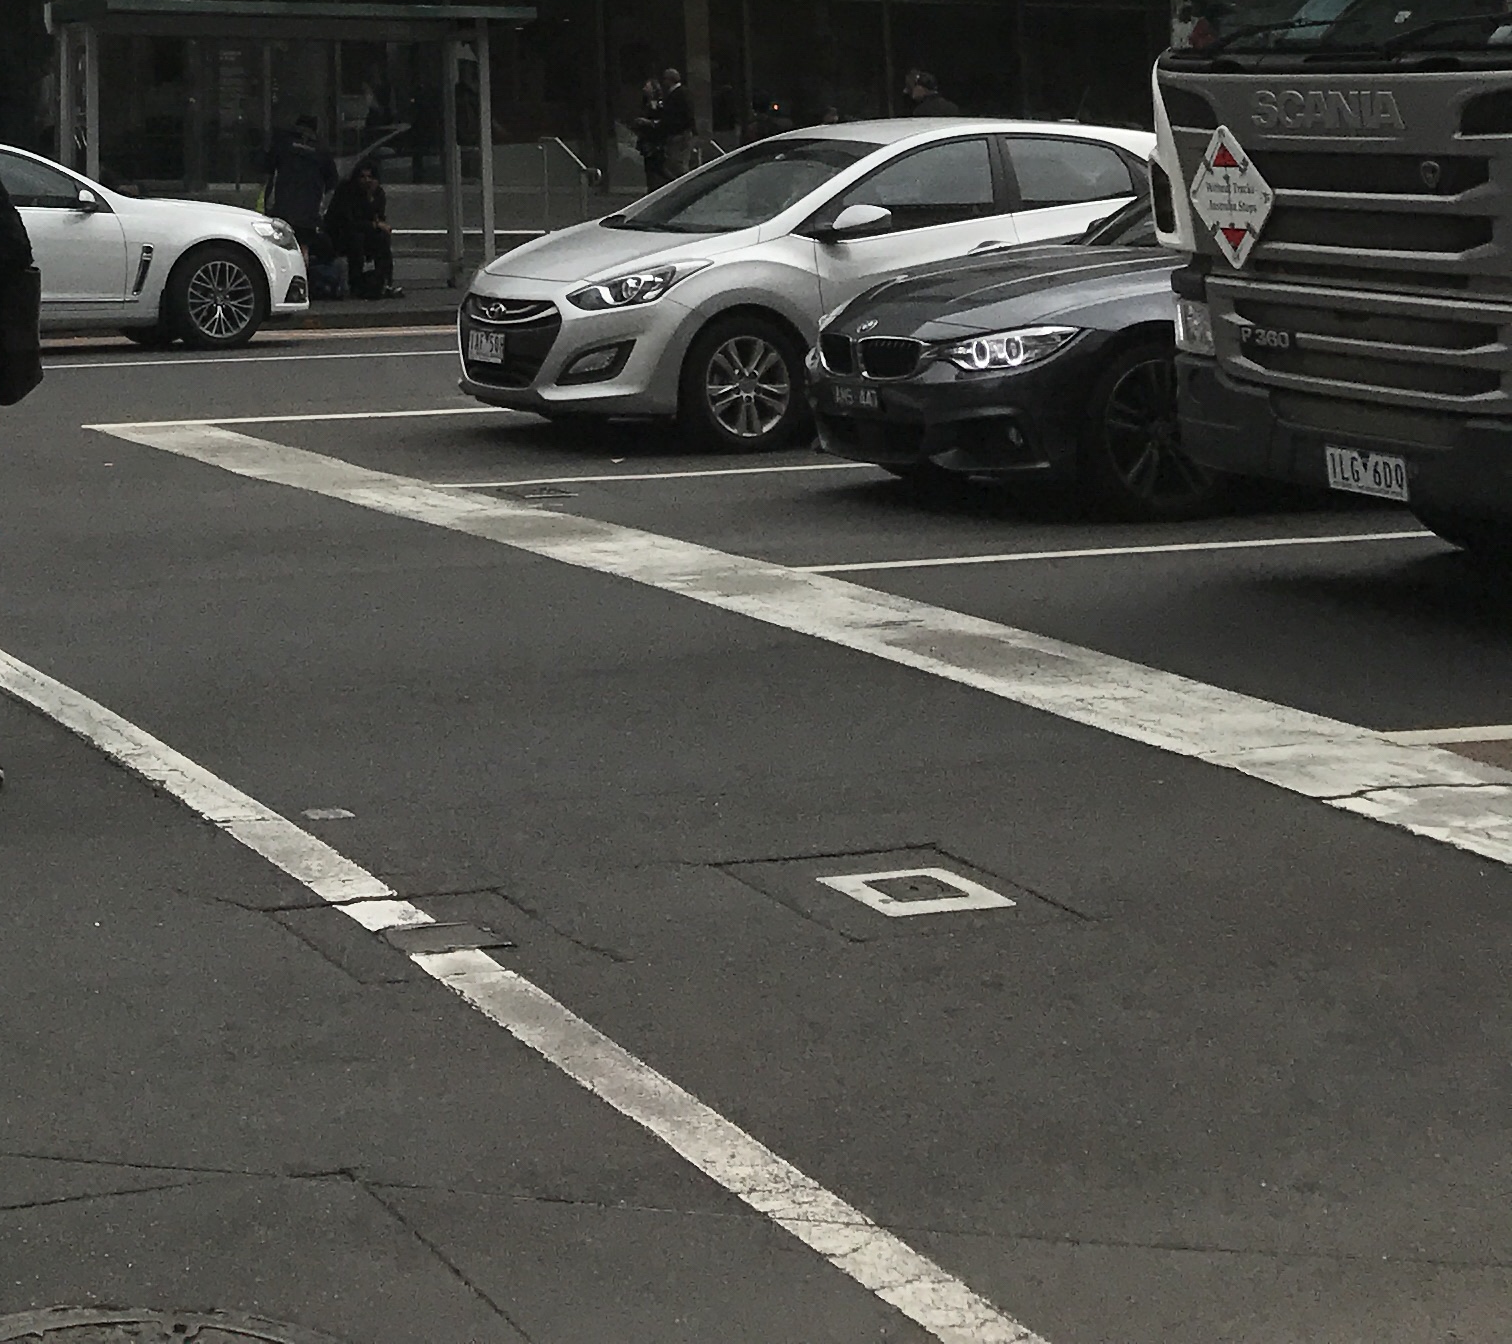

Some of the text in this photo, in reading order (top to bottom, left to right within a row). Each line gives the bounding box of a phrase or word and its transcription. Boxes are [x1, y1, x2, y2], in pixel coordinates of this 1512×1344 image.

[1251, 90, 1406, 129] SCANIA
[1240, 326, 1290, 349] P 360
[1330, 452, 1361, 483] 1LG
